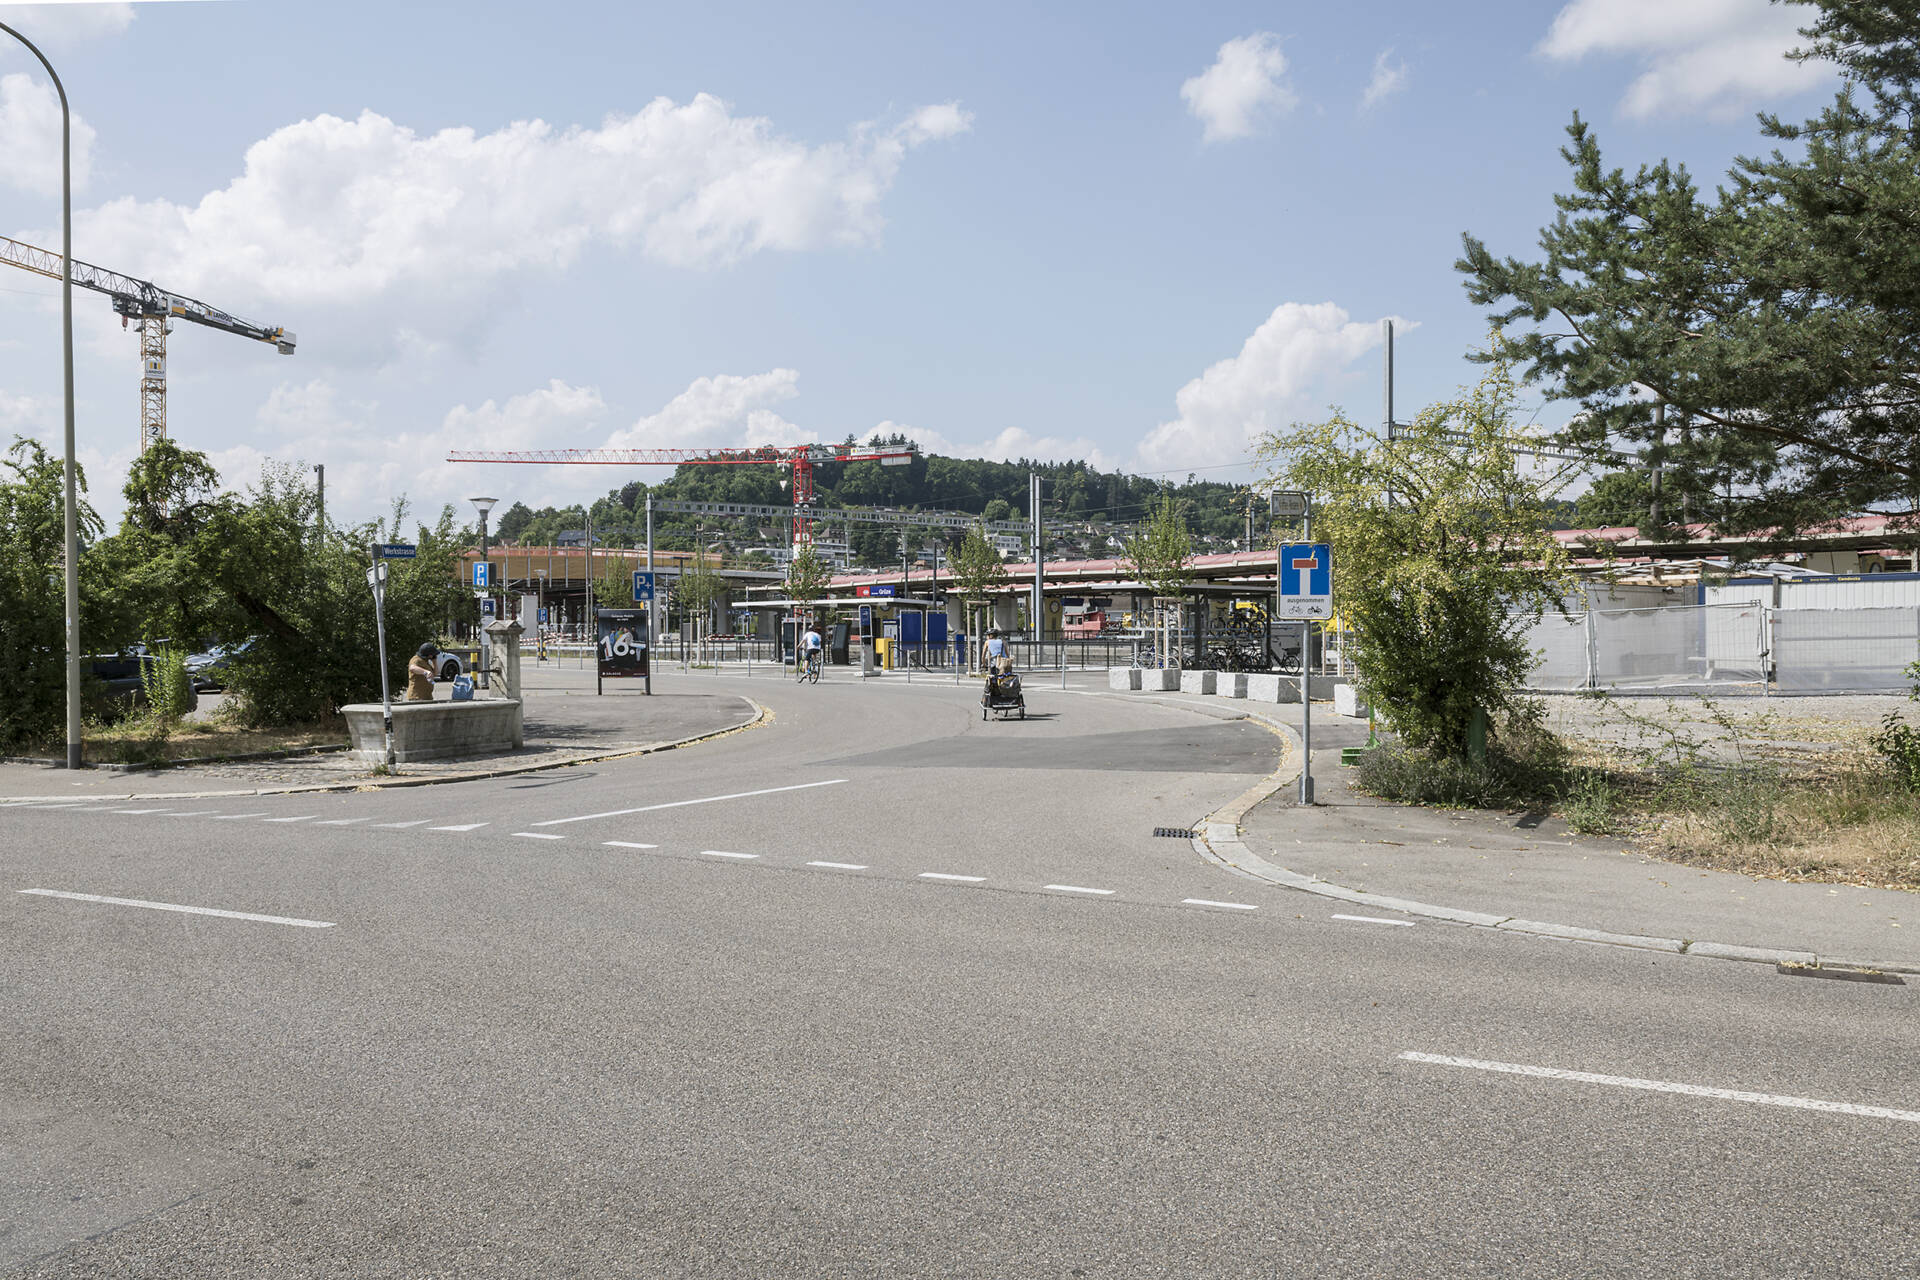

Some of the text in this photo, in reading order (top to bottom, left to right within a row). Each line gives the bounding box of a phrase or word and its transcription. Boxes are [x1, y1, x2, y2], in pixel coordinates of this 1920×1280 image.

[151, 426, 159, 436] 2
[384, 547, 415, 555] Werkstrasse
[477, 565, 485, 577] P
